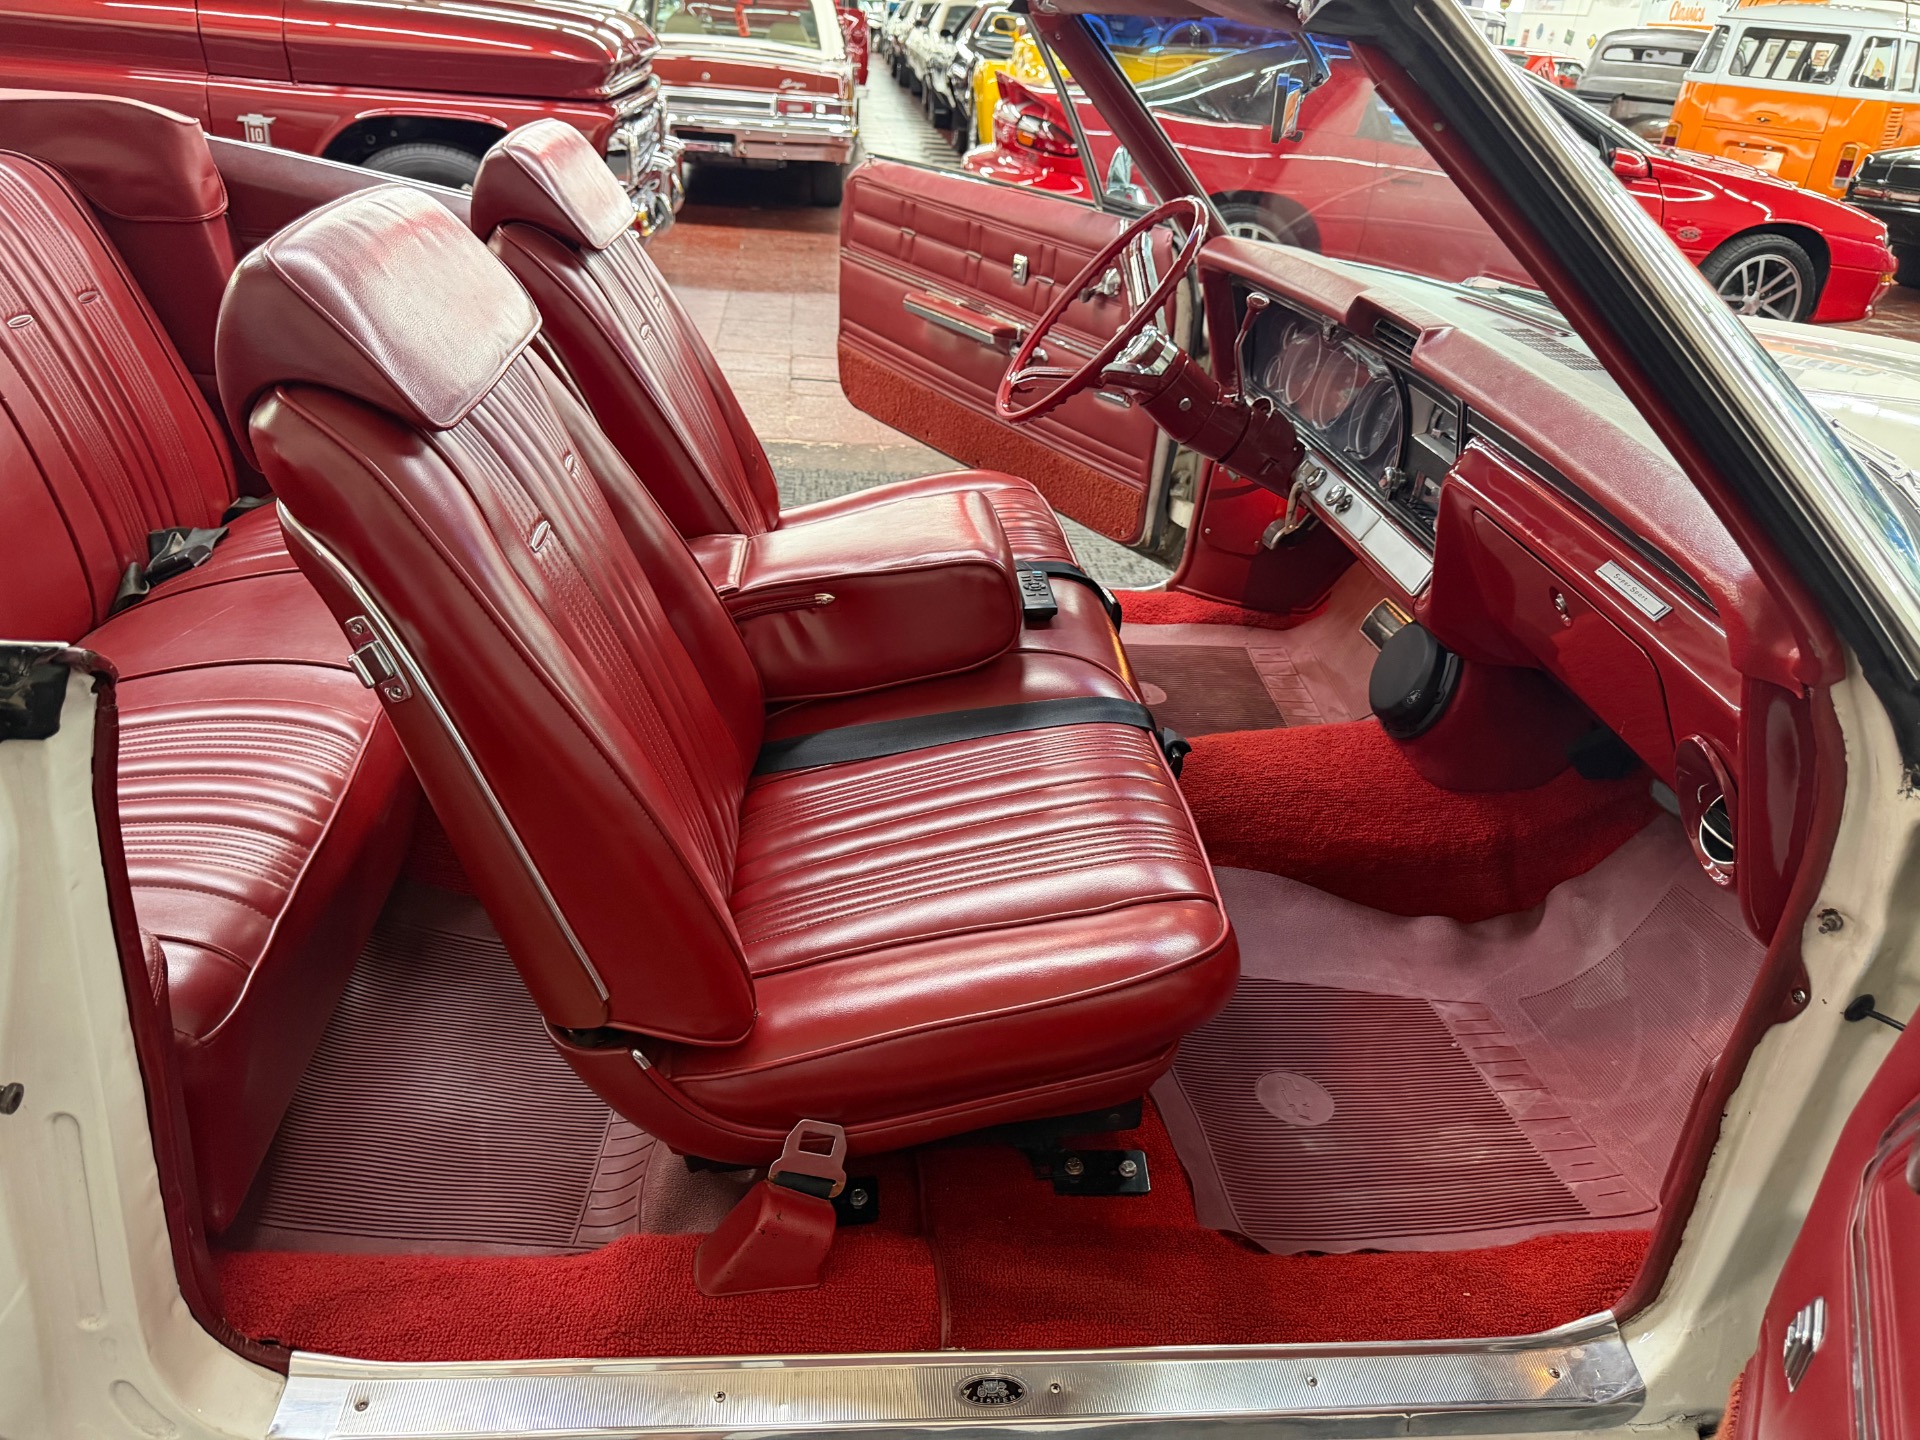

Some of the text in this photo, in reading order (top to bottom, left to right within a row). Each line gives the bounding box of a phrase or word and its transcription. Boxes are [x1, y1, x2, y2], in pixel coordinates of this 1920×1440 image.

[250, 127, 263, 142] 10
[1680, 229, 1698, 239] SS
[1613, 573, 1648, 602] Super Sport
[972, 1394, 1016, 1404] FISHER
